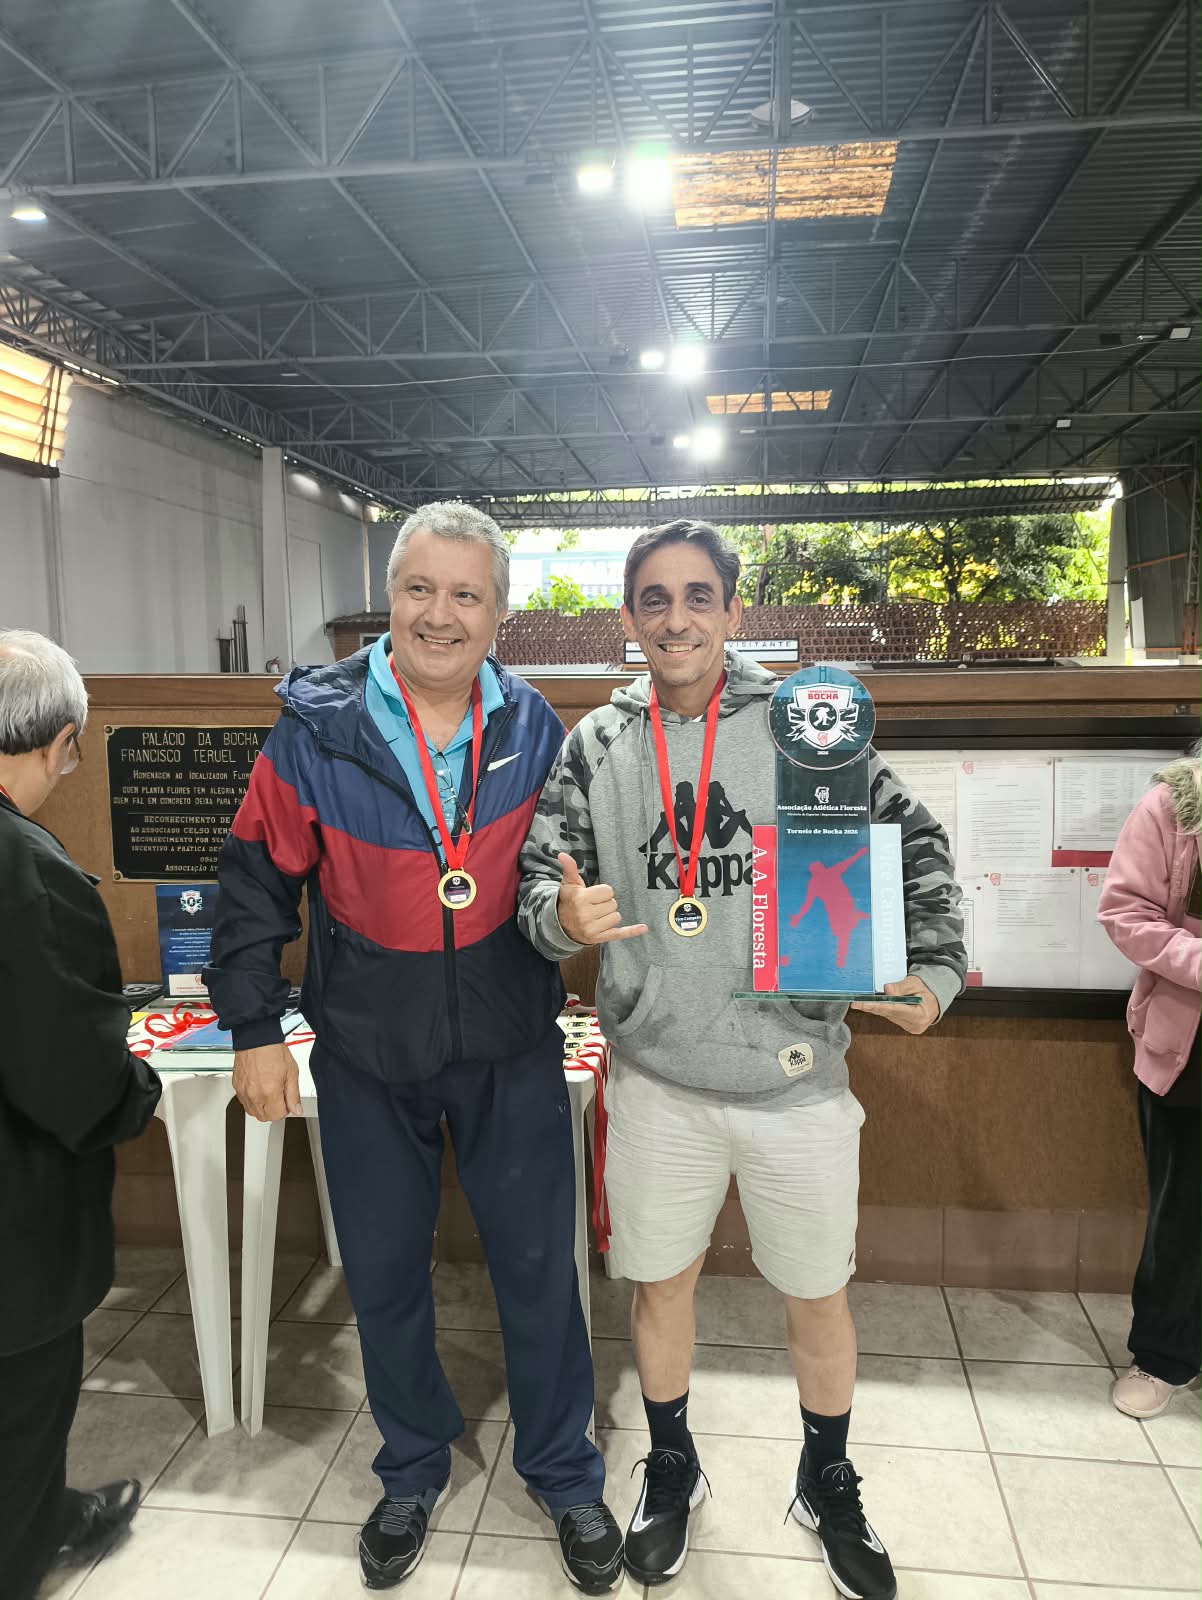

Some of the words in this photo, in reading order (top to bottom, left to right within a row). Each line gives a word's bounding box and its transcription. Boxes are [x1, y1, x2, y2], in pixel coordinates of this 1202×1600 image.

[142, 730, 185, 746] PALÁCIO
[198, 732, 212, 746] DA
[223, 732, 258, 746] BOCHA
[120, 749, 181, 762] FRANCISCO
[193, 750, 236, 762] TERUEL
[144, 816, 216, 824] RECONHECIMENTO
[752, 845, 768, 863] A.
[752, 870, 768, 888] A.
[753, 893, 769, 968] Floresta
